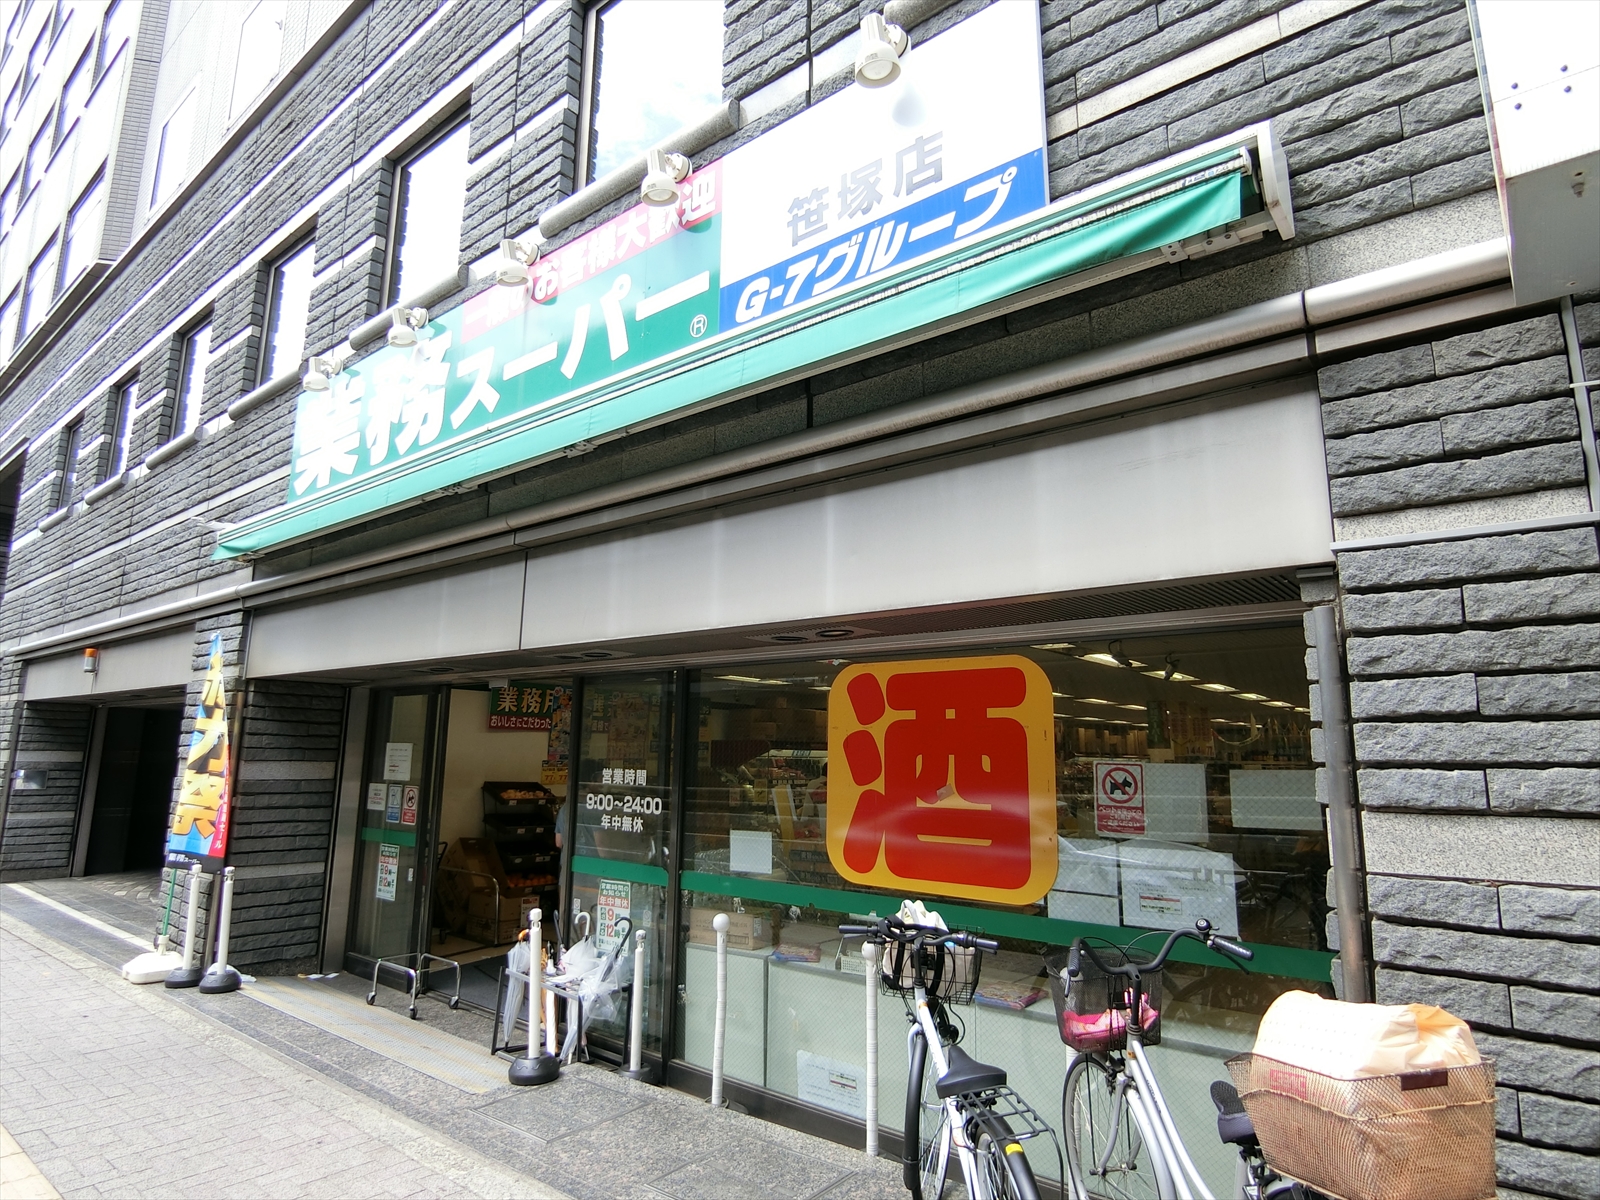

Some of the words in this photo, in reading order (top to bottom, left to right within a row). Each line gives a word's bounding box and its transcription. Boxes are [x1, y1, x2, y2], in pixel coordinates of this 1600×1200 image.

[787, 131, 943, 247] 笹塚店
[735, 166, 1017, 323] G-7グループ
[293, 270, 709, 495] 業務スーパー
[490, 715, 551, 729] おいしさにこだわった
[602, 768, 647, 786] 営業時間
[843, 667, 1031, 889] 酒
[601, 814, 643, 833] 年中無休
[600, 896, 629, 908] 年中無休
